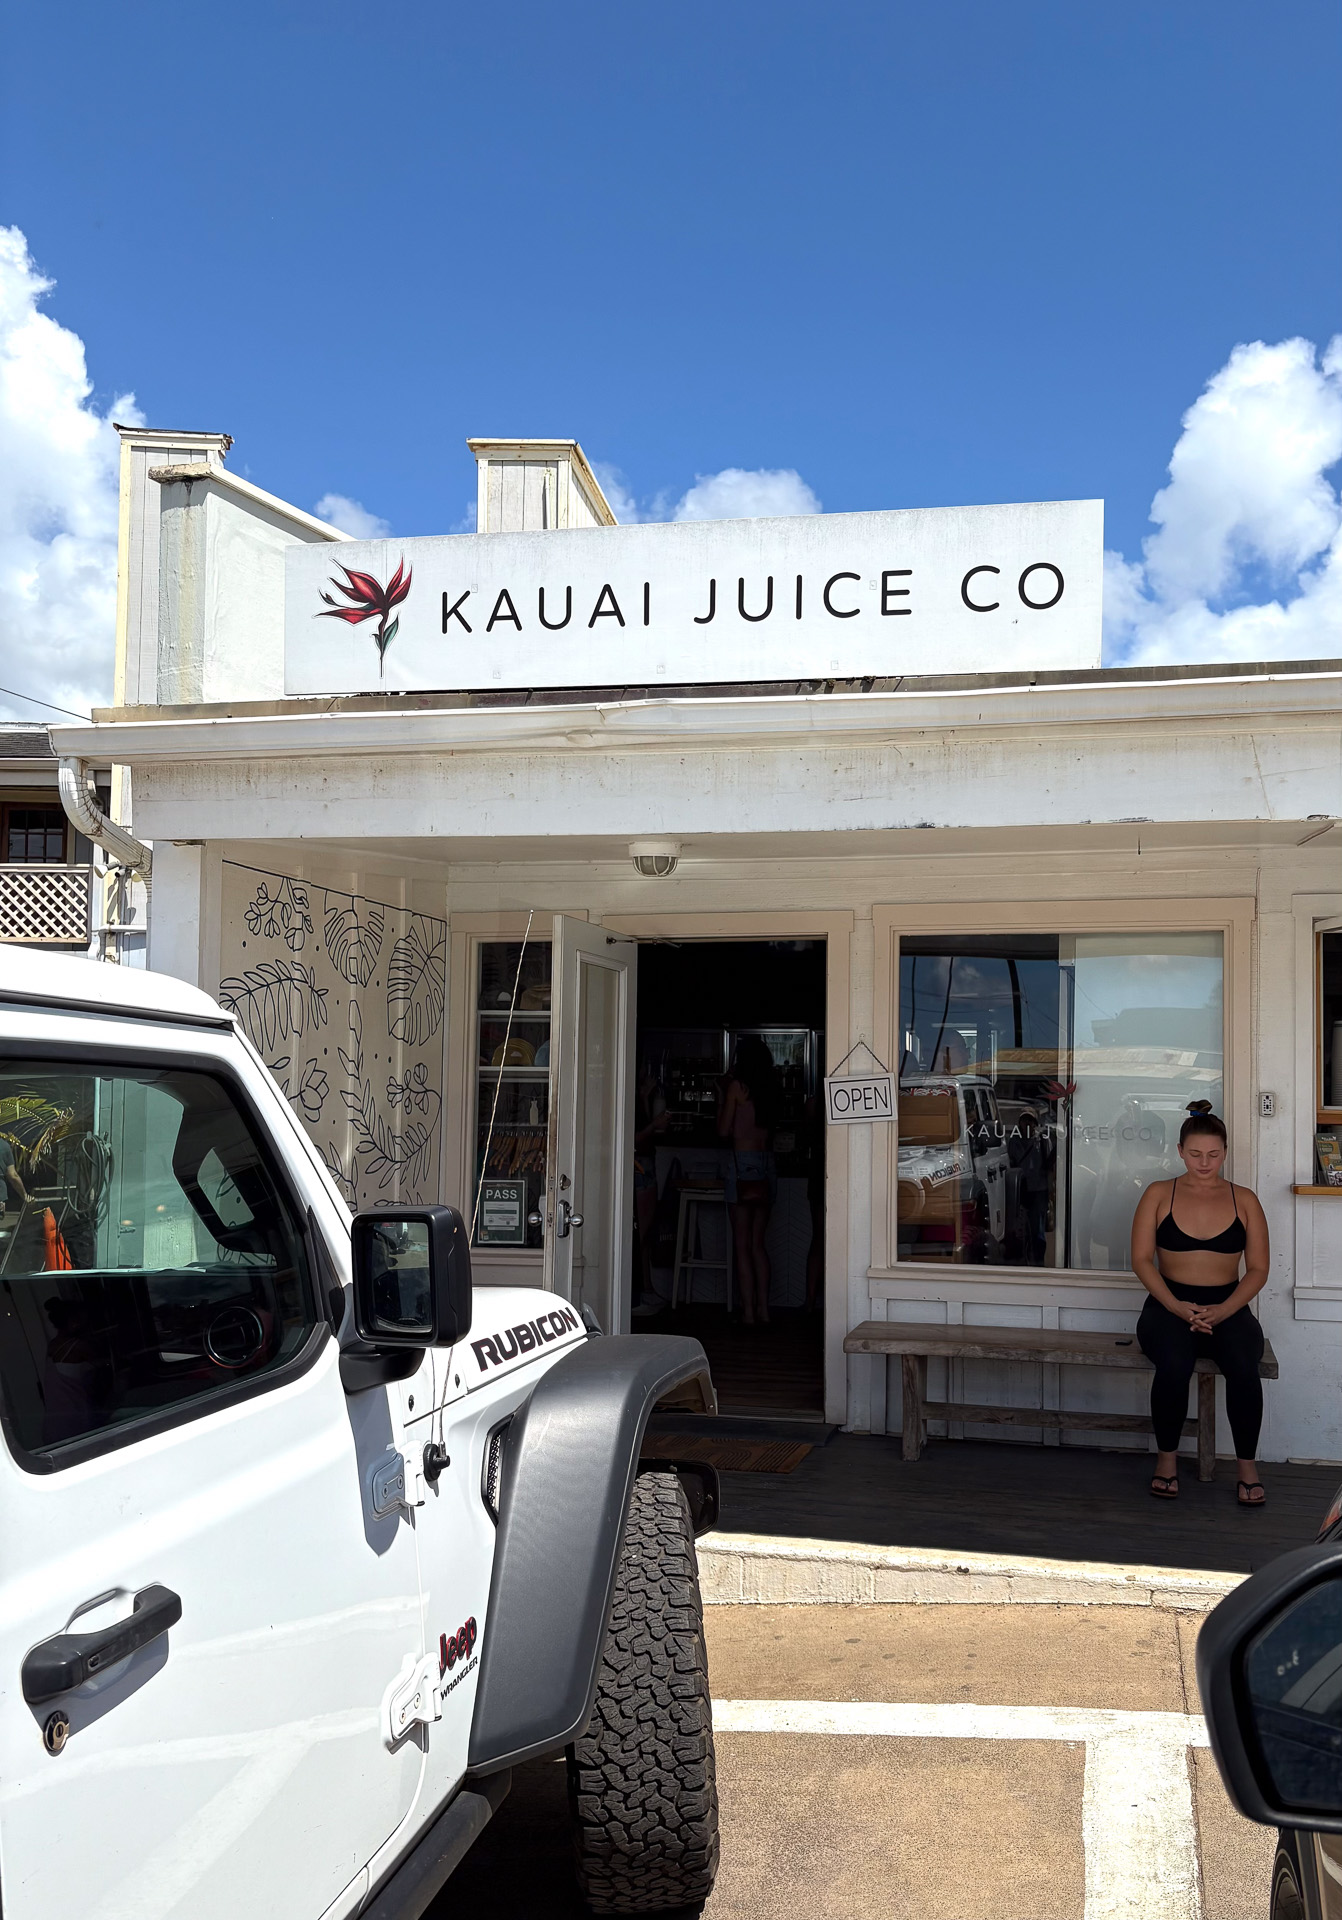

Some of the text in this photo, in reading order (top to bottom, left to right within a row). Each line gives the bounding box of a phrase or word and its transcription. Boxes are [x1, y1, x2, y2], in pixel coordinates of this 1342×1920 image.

[441, 562, 1065, 635] KAUAI JUICE CO
[833, 1085, 889, 1112] OPEN
[963, 1124, 1031, 1139] KAUAI
[1121, 1127, 1152, 1141] CO
[485, 1189, 518, 1200] PASS
[470, 1306, 580, 1373] RUBICON
[439, 1616, 478, 1681] Jeep
[440, 1655, 479, 1701] WRANGLER
